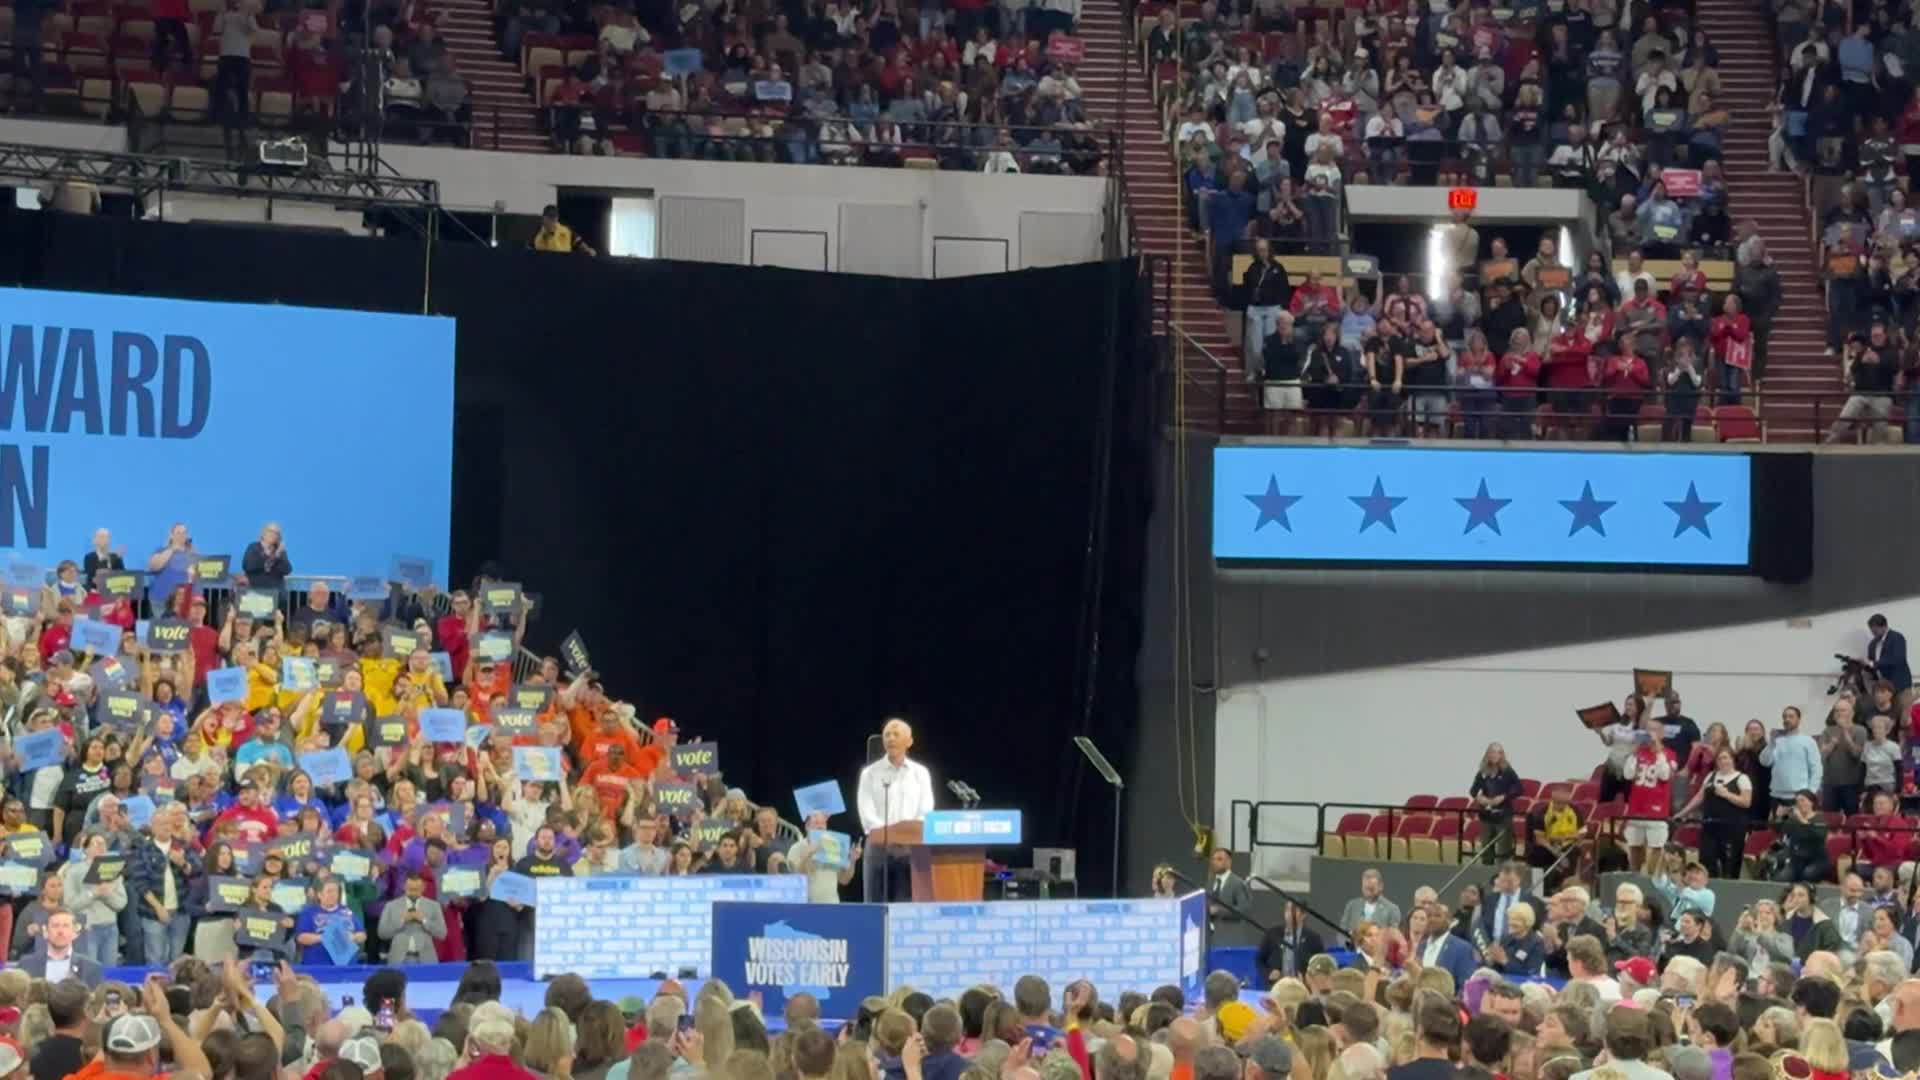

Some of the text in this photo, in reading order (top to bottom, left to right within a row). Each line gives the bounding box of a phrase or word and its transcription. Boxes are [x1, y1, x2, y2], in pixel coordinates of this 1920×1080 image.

[0, 324, 211, 439] WARD
[154, 624, 190, 641] vote
[568, 638, 589, 669] vote
[498, 713, 532, 727] vote
[675, 749, 713, 766] vote
[658, 788, 693, 806] vote
[747, 935, 849, 963] WISCONSIN
[744, 961, 850, 987] VOTES EARLY
